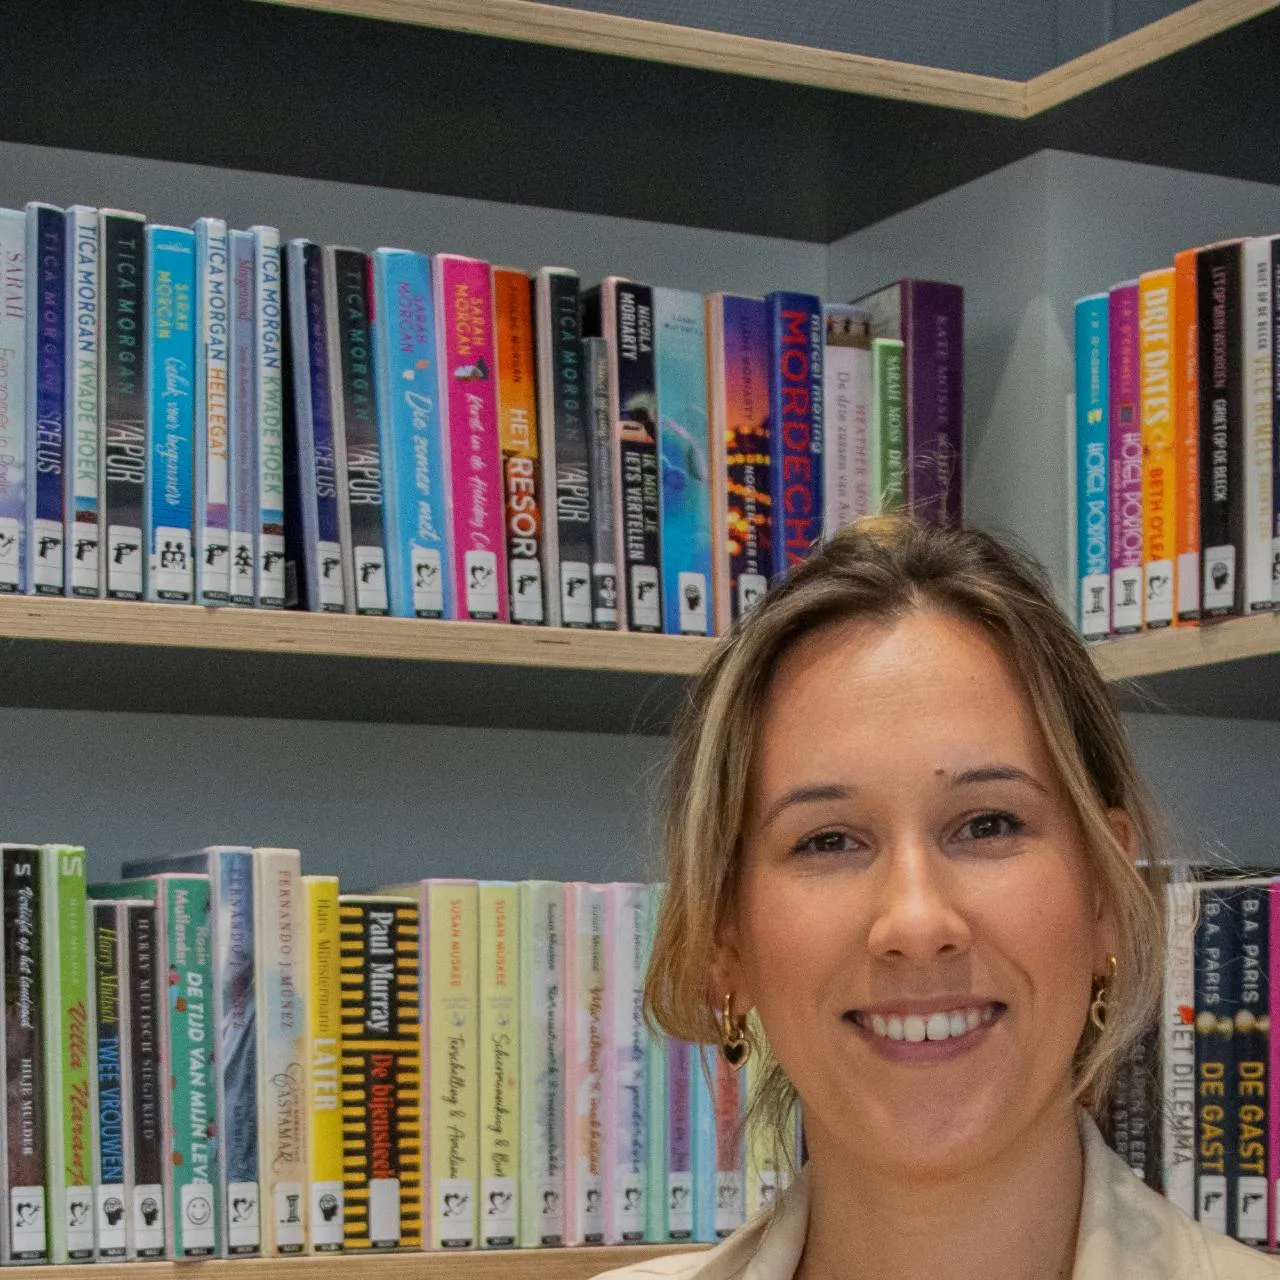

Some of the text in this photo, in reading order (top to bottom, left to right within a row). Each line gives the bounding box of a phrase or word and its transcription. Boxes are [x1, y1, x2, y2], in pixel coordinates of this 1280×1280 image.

[76, 225, 97, 480] TICA MORGAN KWADE HOEK
[620, 292, 637, 360] MORIARTY
[637, 305, 650, 353] NICOLA
[366, 911, 394, 1035] Paul Murray
[312, 1038, 339, 1112] LATER
[1238, 1061, 1263, 1175] DE GAST
